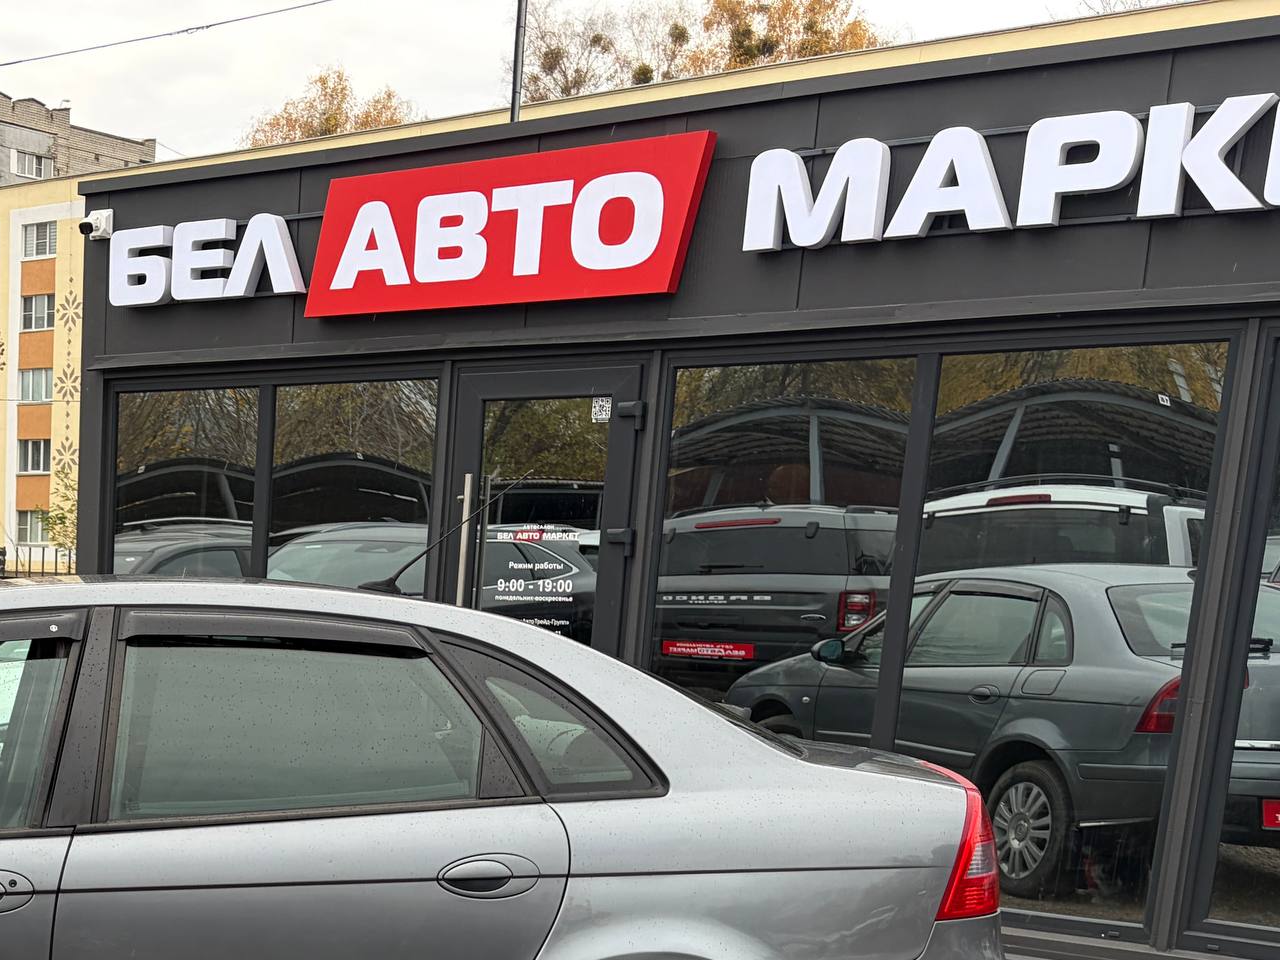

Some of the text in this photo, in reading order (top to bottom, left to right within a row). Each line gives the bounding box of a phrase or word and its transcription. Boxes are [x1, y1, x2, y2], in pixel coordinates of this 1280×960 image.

[109, 92, 1280, 307] БЕЛ АВТО МАРК
[497, 532, 580, 540] БЕЛ АВТО МАРКЕТ
[508, 561, 564, 571] Режим работы
[497, 579, 525, 592] 9:00
[537, 580, 573, 593] 19:00
